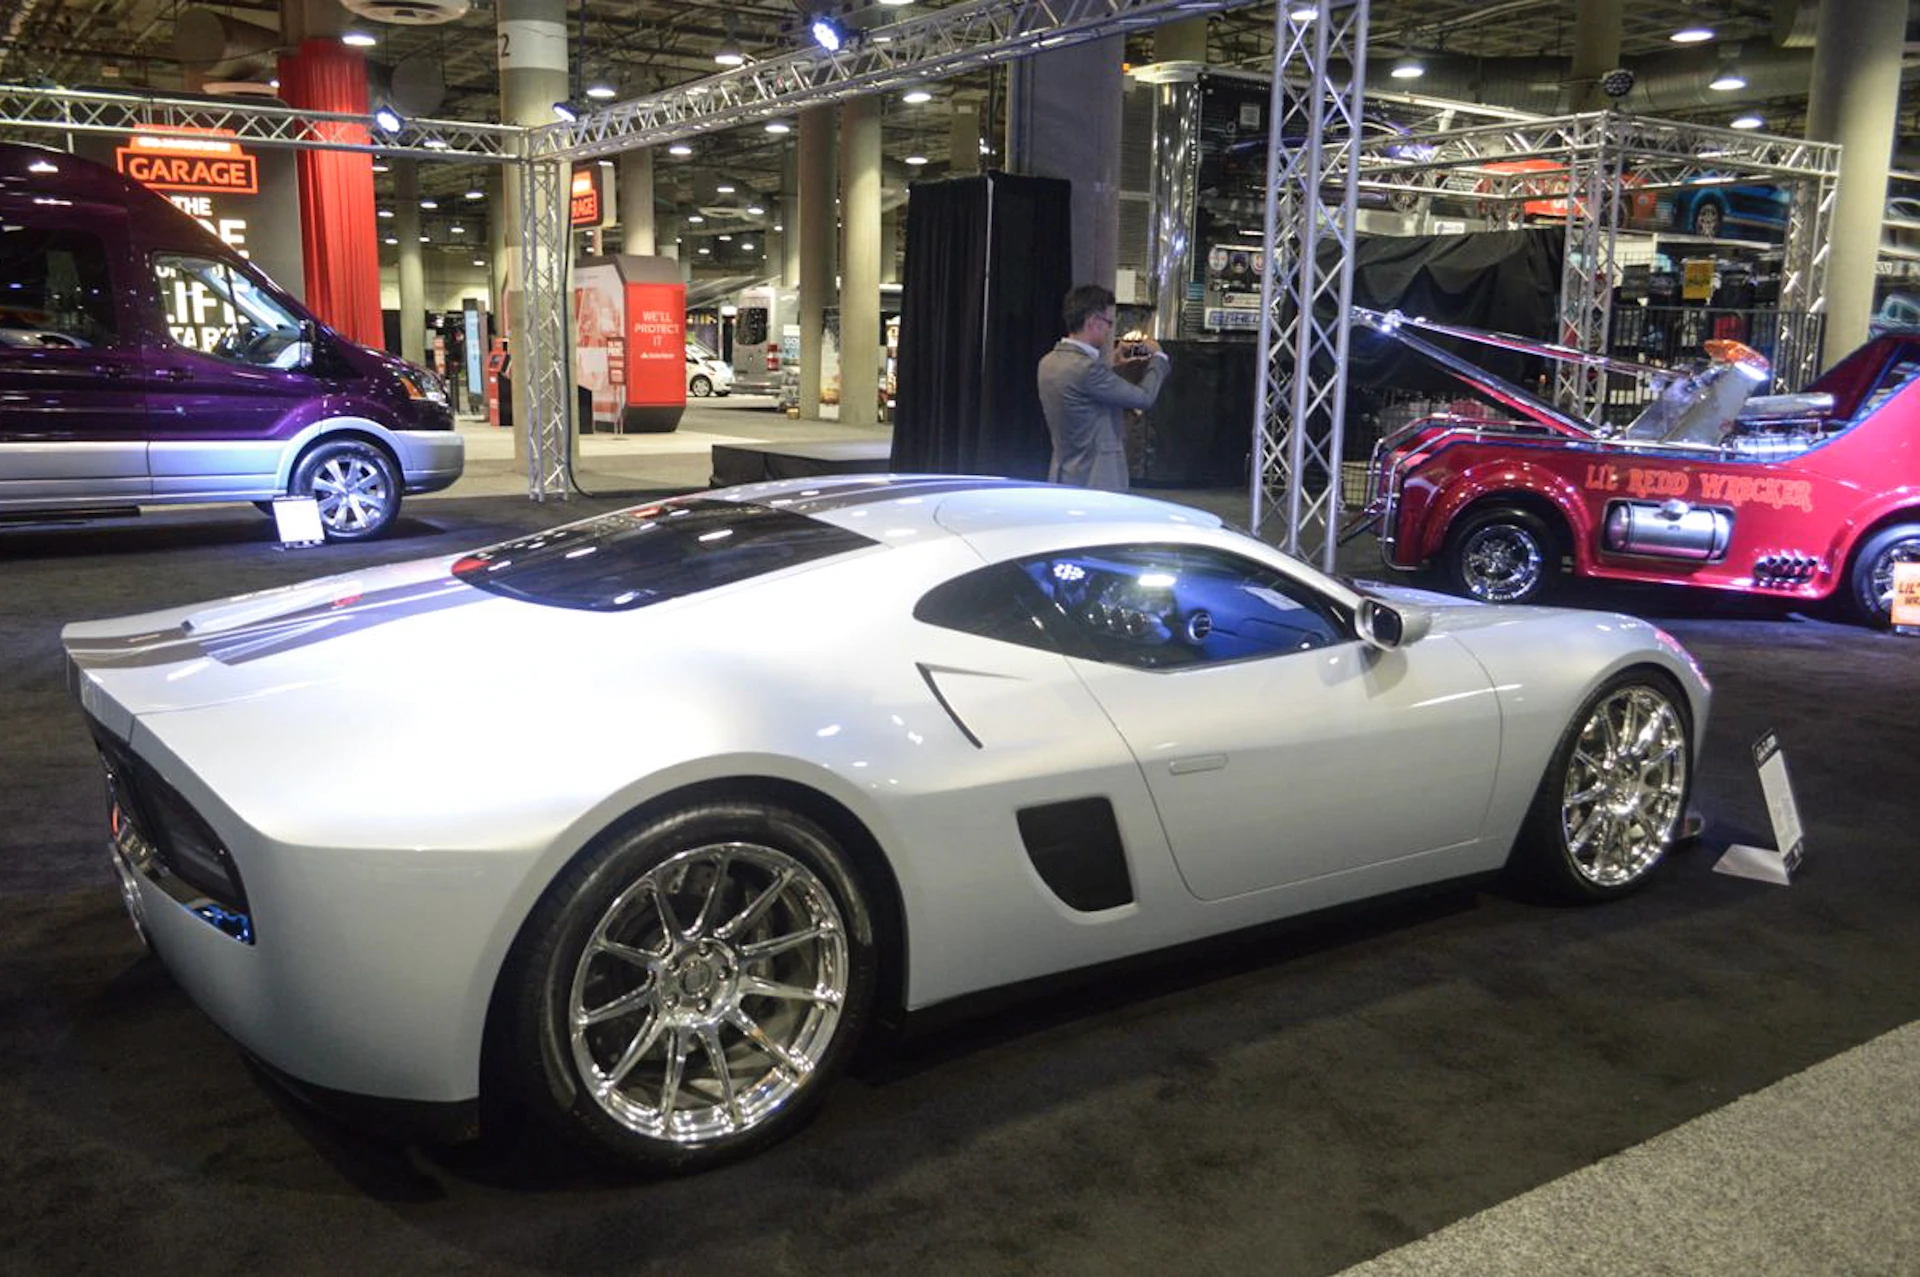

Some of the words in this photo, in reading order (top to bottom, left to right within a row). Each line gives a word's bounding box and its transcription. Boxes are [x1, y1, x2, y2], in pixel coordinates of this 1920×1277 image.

[129, 156, 247, 186] GARAGE
[170, 195, 213, 217] THE
[642, 311, 673, 322] WE'LL
[634, 323, 679, 334] PROTECT
[653, 335, 662, 346] IT
[1626, 468, 1689, 498] REDD
[1699, 473, 1812, 513] WRECKER
